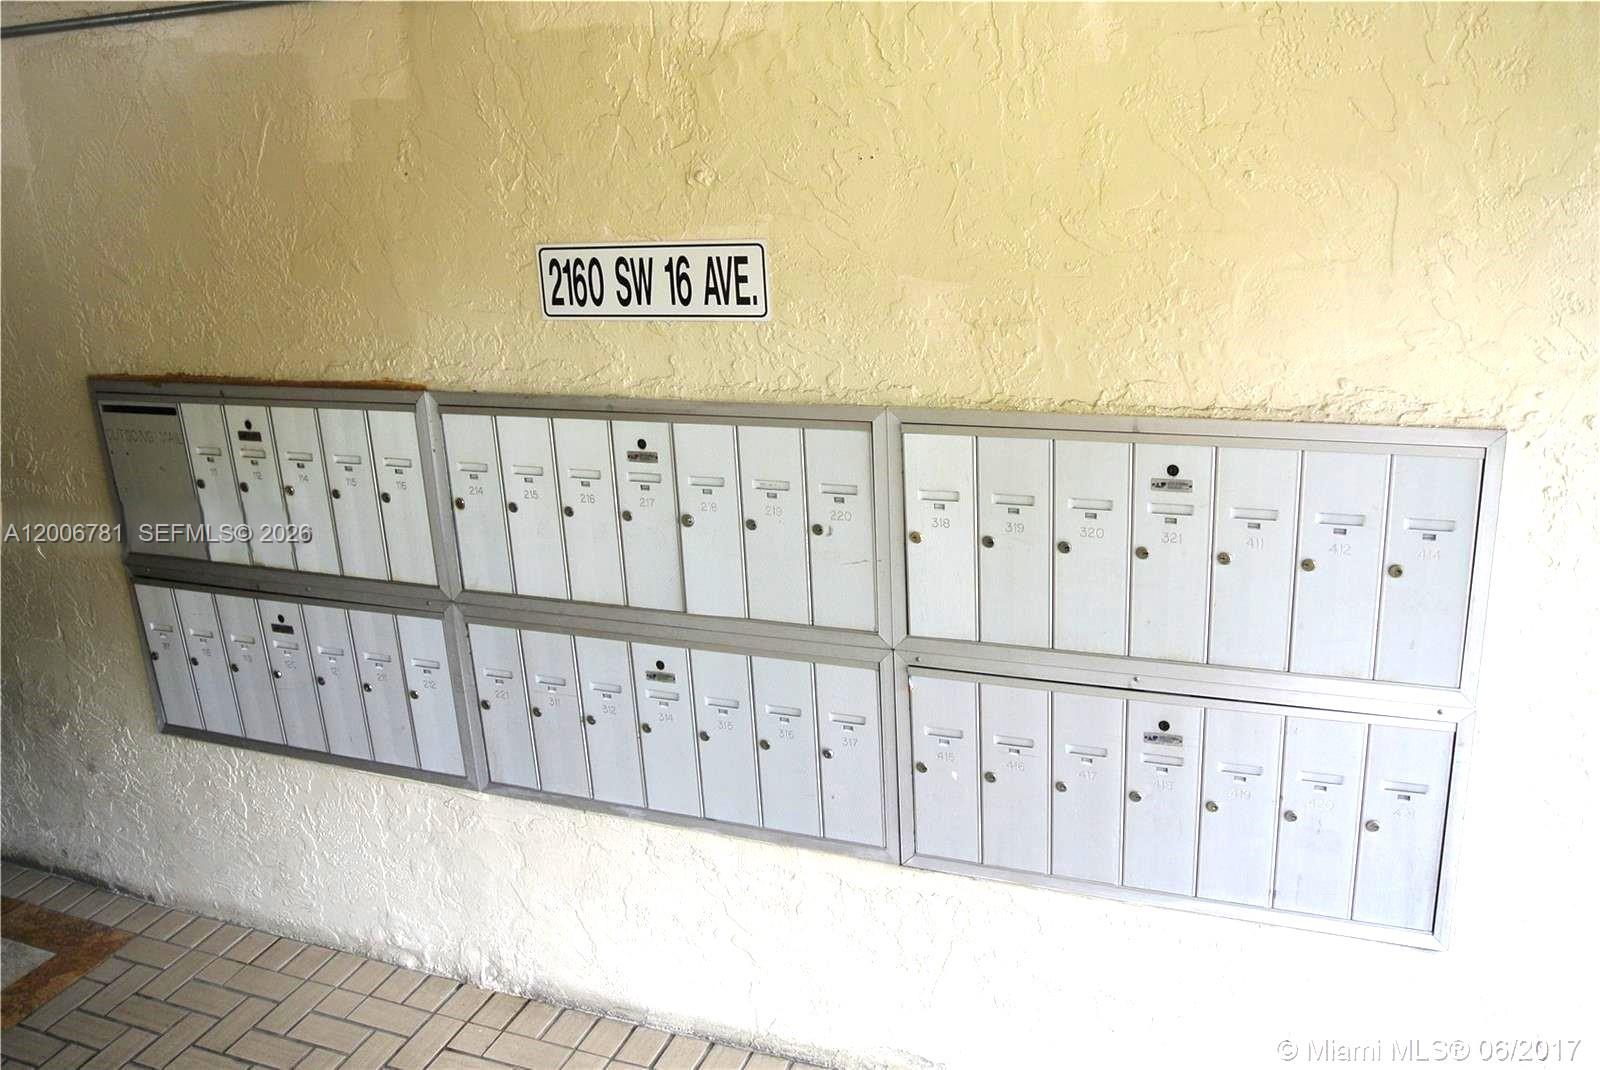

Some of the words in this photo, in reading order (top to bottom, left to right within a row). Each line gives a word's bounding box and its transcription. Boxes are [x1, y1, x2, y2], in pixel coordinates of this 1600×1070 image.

[549, 257, 604, 307] 2160
[615, 256, 653, 307] SW
[664, 255, 693, 307] 16
[704, 255, 759, 306] AVE.
[469, 486, 484, 495] 214
[523, 489, 538, 499] 215
[580, 493, 596, 504] 216
[639, 497, 656, 508] 217
[700, 502, 718, 512] 218
[764, 505, 783, 517] 219
[830, 510, 852, 521] 220
[931, 518, 951, 529] 318
[1004, 522, 1025, 534] 319
[1079, 527, 1104, 539] 320
[1160, 532, 1183, 545] 321
[1245, 536, 1264, 550] 411
[1328, 543, 1352, 556] 412
[600, 704, 617, 715] 312
[658, 711, 673, 722] 314
[841, 736, 859, 748] 317
